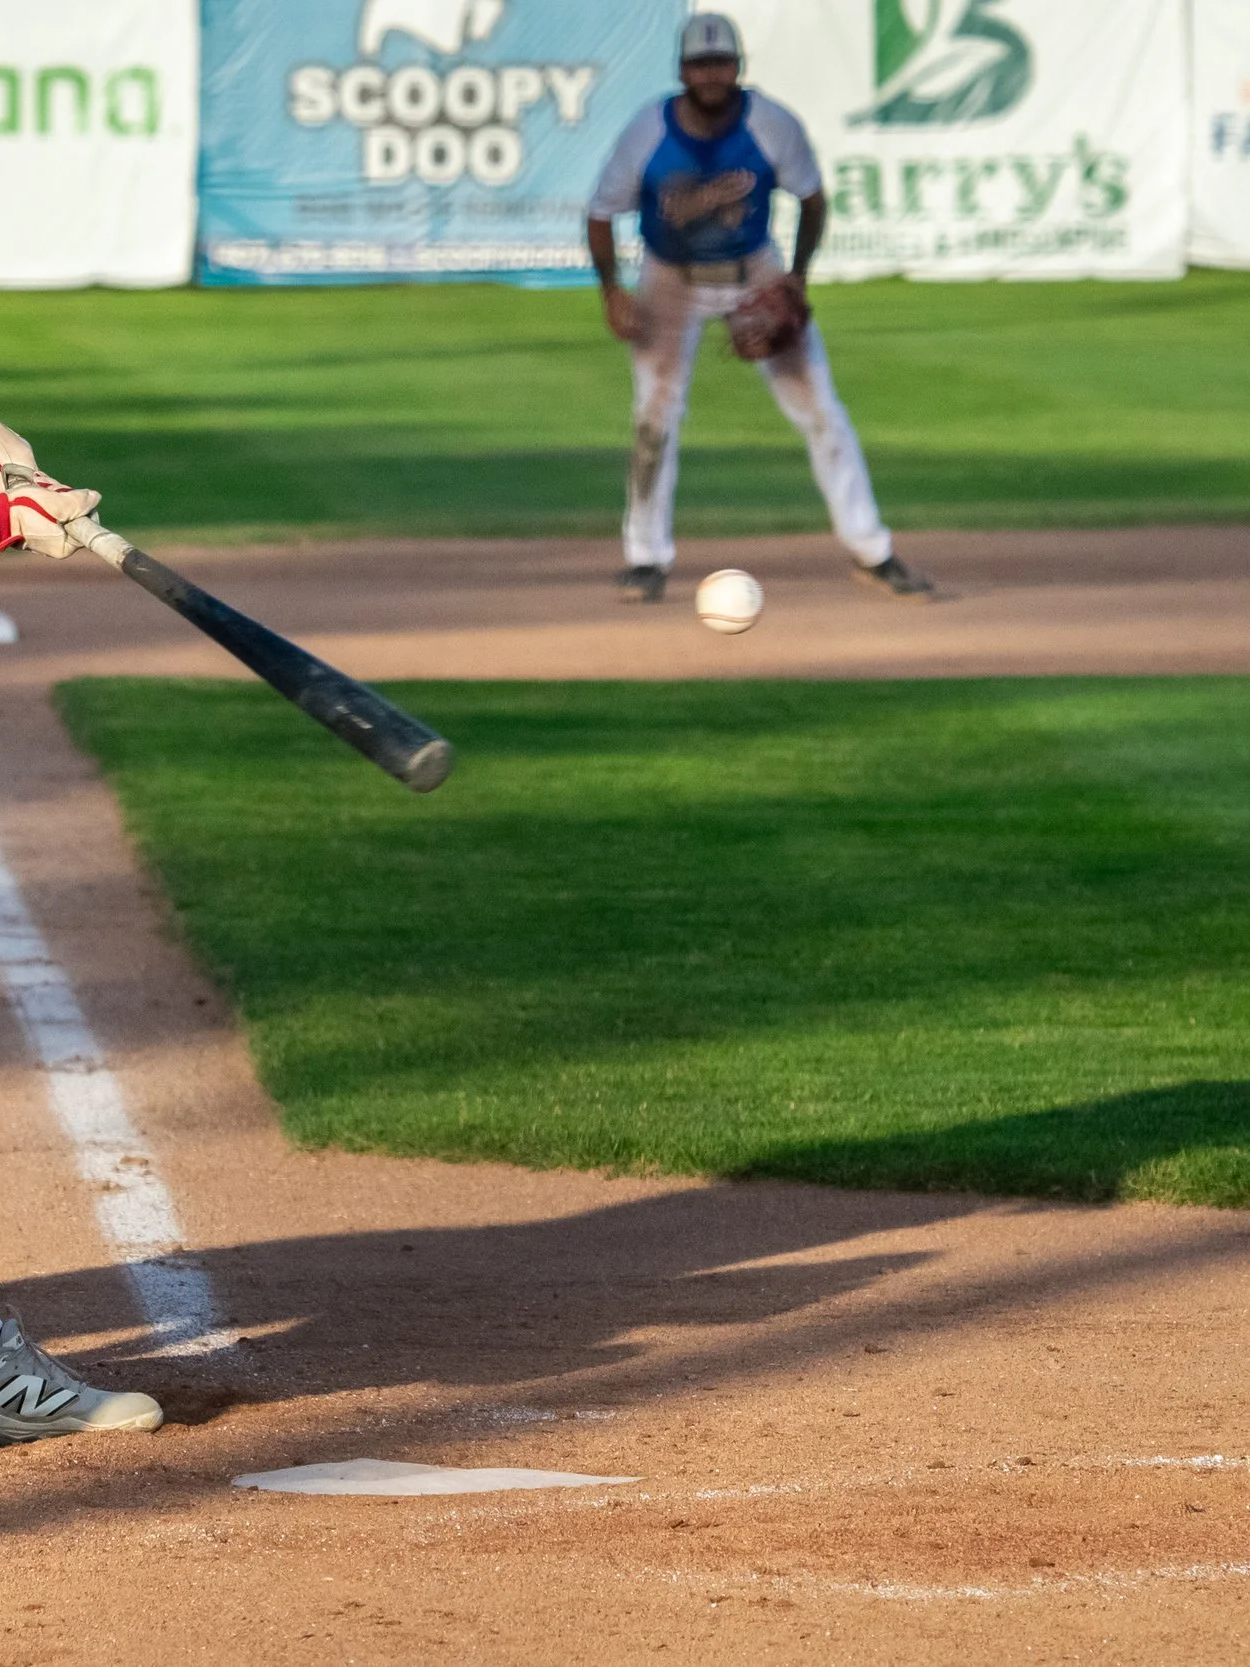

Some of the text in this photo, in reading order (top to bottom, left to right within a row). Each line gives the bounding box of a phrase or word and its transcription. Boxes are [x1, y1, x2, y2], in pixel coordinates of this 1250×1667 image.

[289, 65, 594, 127] SCOOPY
[364, 127, 523, 186] DOO
[832, 132, 1130, 222] arry's
